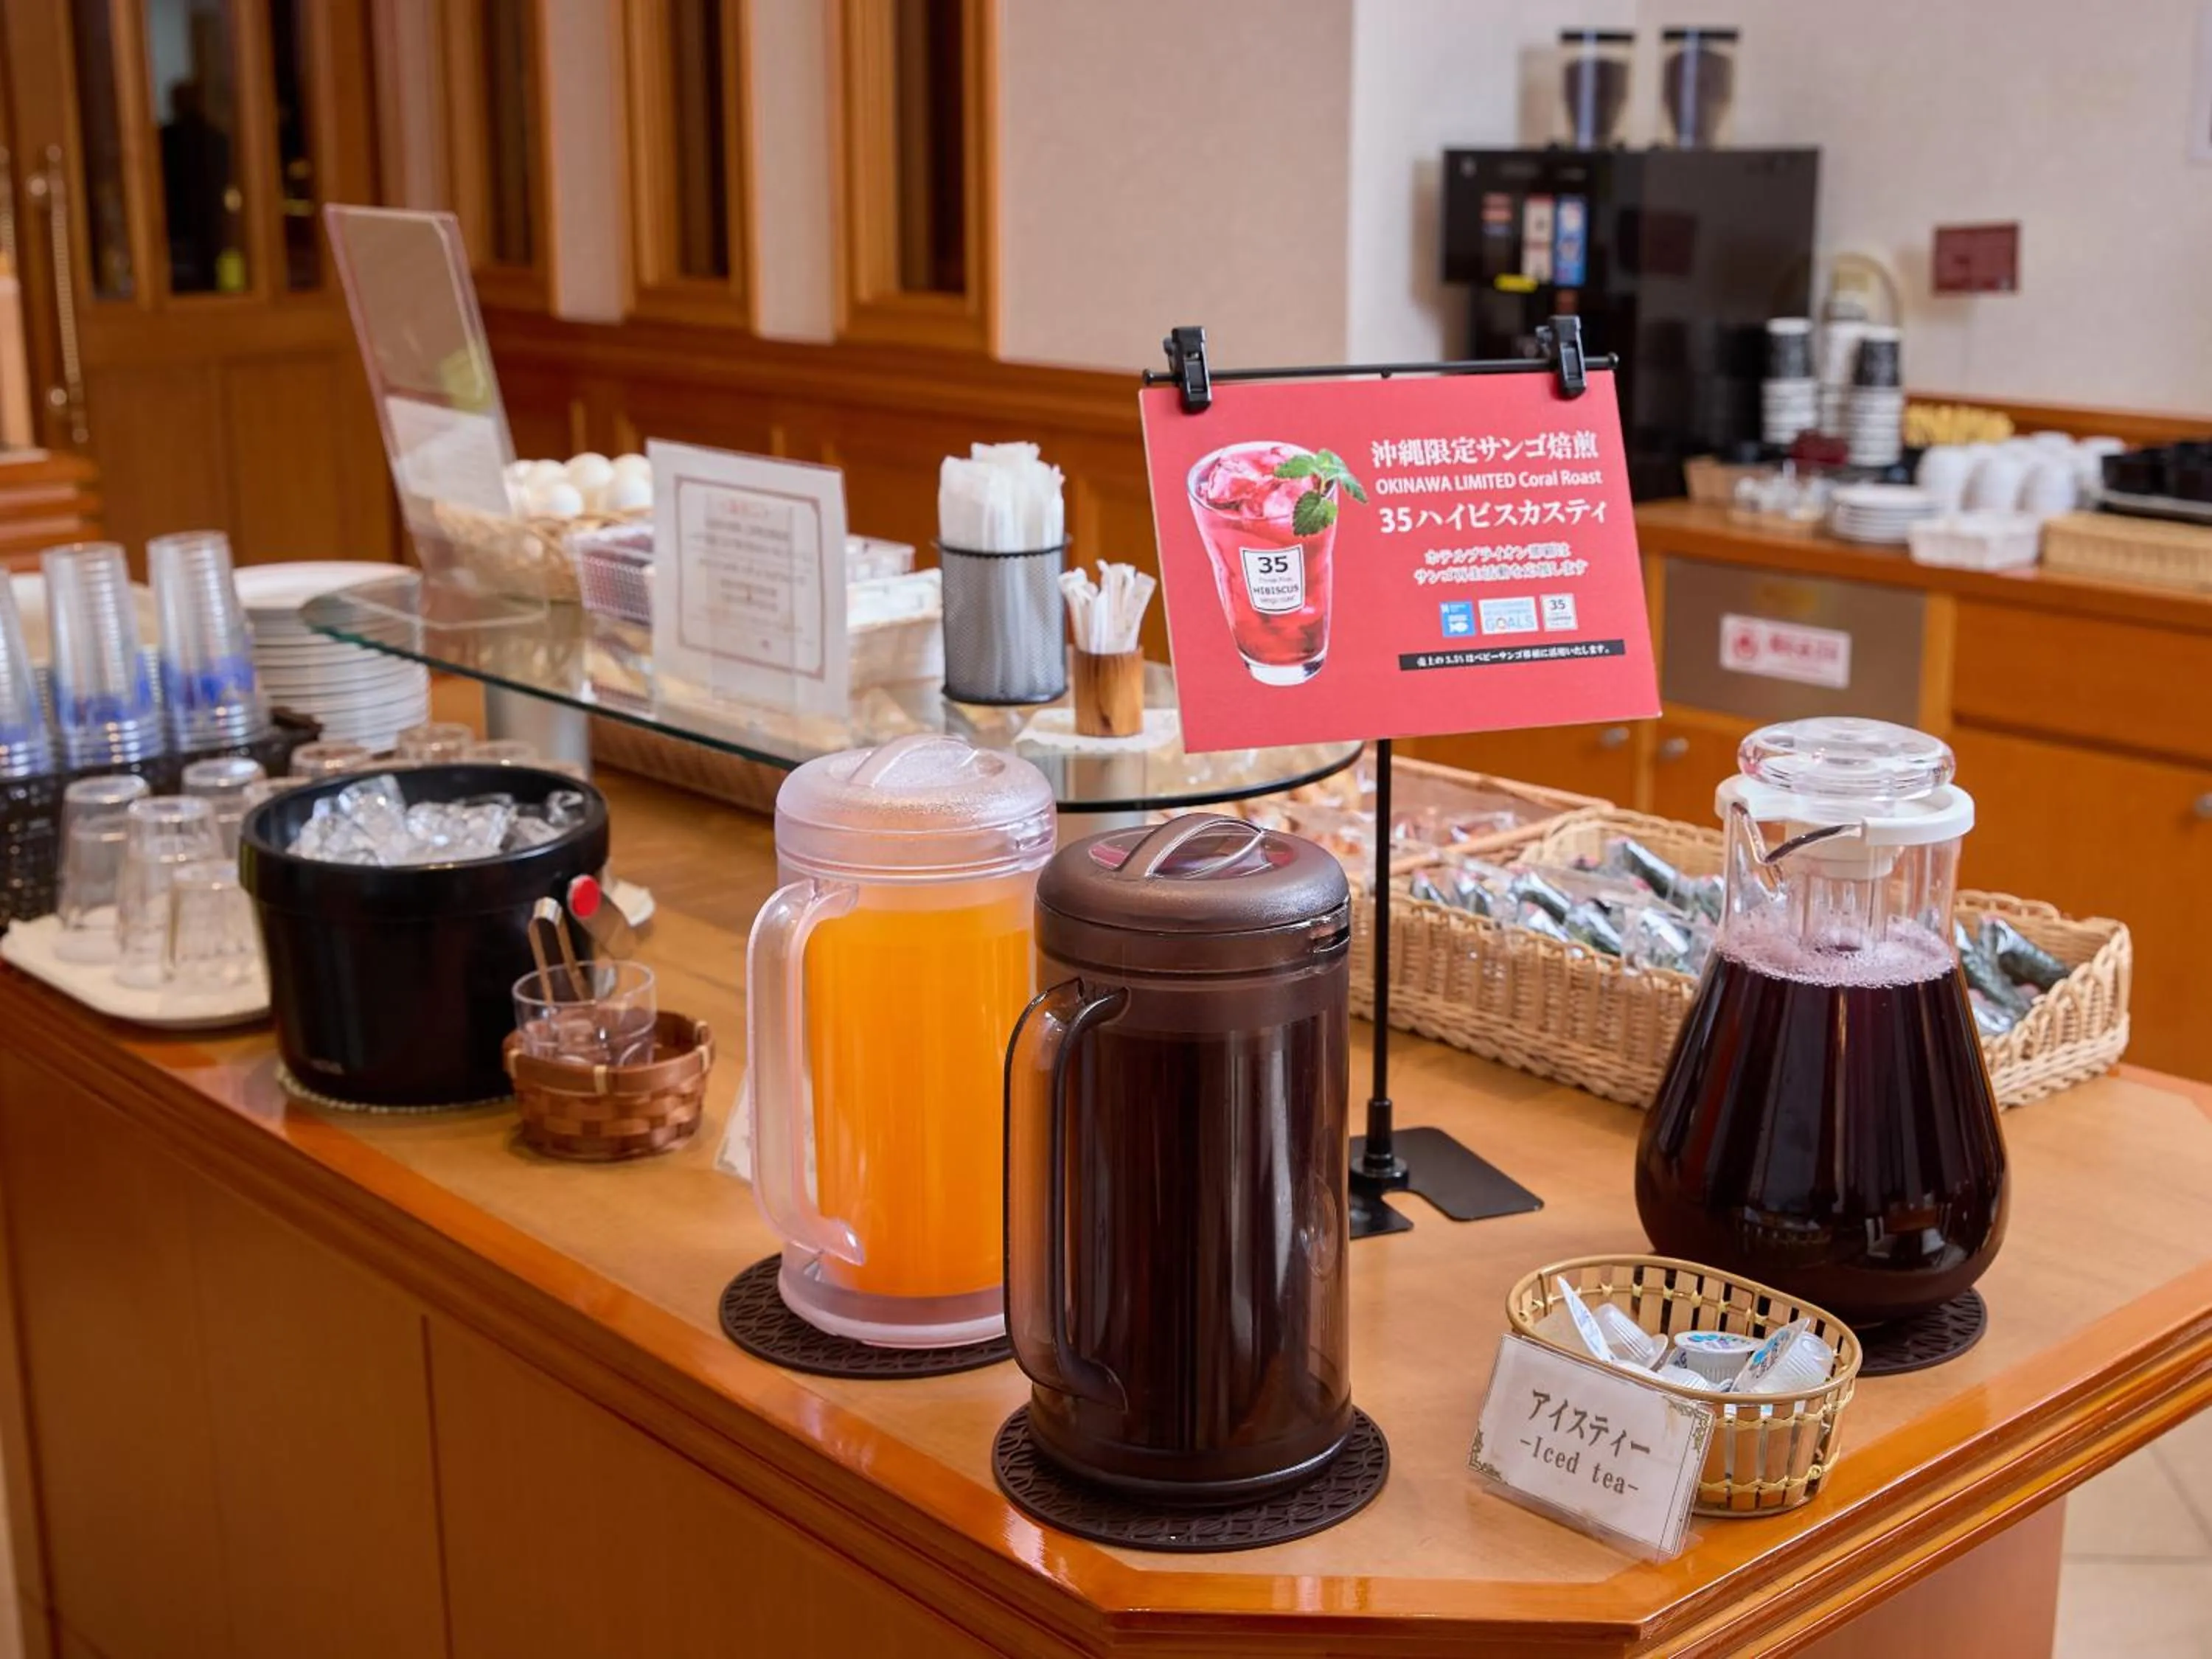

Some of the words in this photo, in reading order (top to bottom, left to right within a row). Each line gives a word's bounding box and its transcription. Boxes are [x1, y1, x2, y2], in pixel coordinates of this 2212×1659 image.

[1371, 431, 1599, 468] 沖縄限定サンゴ焙煎
[1375, 476, 1452, 495] OKINAWA
[1455, 472, 1515, 491] LIMITED
[1519, 470, 1558, 488] Coral
[1561, 470, 1603, 486] Roast
[1258, 556, 1288, 574] 35
[1253, 584, 1298, 595] HIBISCUS
[1550, 599, 1565, 611] 35
[1485, 615, 1535, 632] GOALS
[1528, 1389, 1650, 1458] アイスティー
